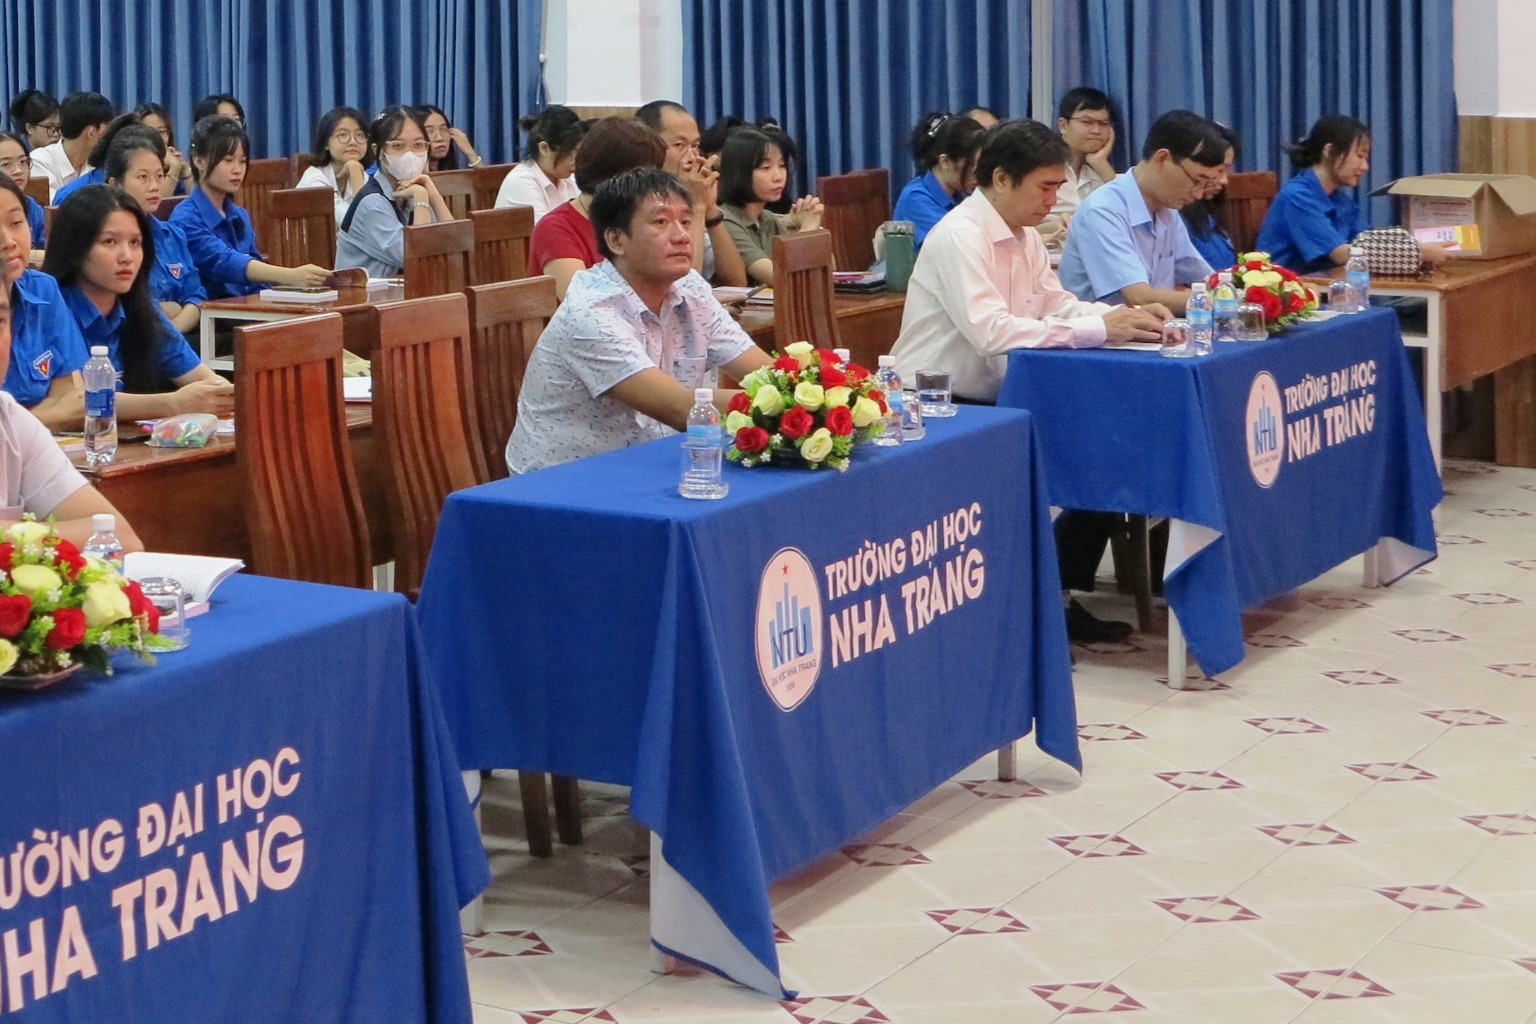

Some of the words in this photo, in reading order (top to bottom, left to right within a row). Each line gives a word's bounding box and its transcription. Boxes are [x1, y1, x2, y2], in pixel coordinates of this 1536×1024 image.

[1284, 373, 1328, 414] TRƯỜNG
[1331, 367, 1349, 402] ĐẠI
[1350, 359, 1376, 395] HỌC
[1287, 413, 1321, 463] NHA
[1323, 393, 1375, 446] TRANG
[825, 537, 907, 601] TRƯỜNG
[911, 518, 938, 569] ĐẠI
[942, 501, 982, 552] HỌC
[772, 623, 807, 666] NTU
[829, 592, 897, 669] NHA
[901, 547, 986, 635] TRANG
[136, 782, 204, 857] ĐẠI
[216, 746, 301, 825] HỌC
[111, 814, 305, 962] TRANG
